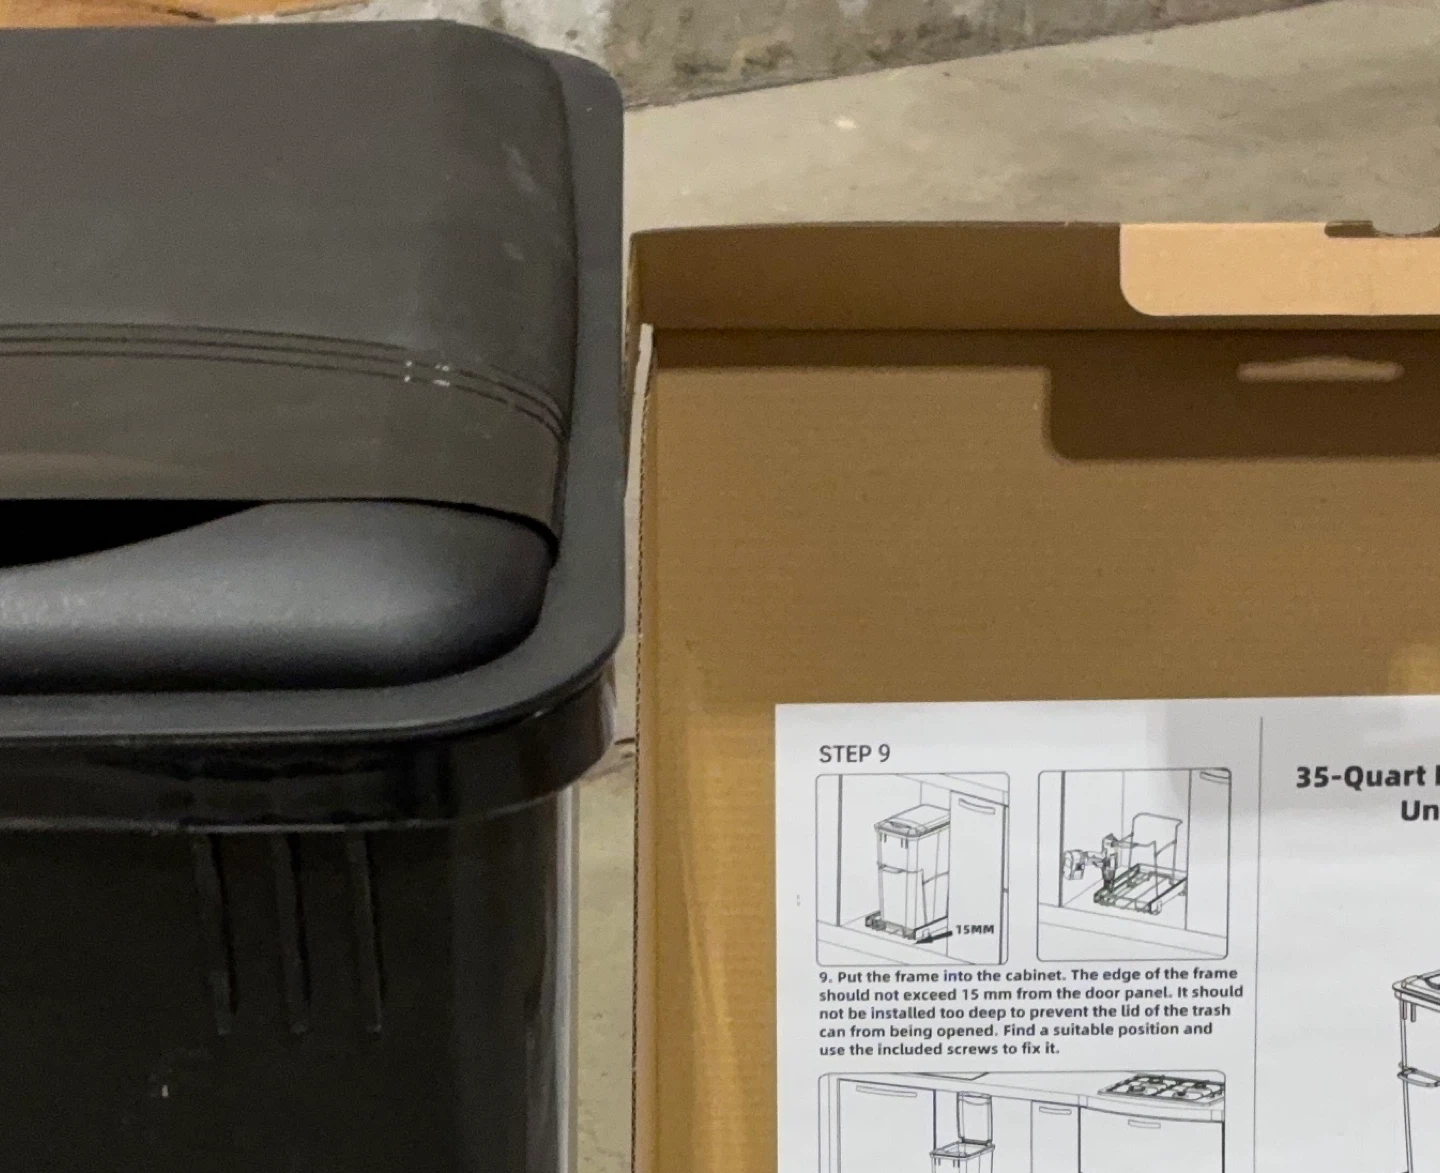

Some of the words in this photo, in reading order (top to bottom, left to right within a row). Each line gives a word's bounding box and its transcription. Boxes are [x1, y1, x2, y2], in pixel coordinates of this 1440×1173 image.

[819, 744, 872, 765] STEP
[878, 743, 890, 764] 9
[1296, 764, 1427, 792] 35-Quart
[956, 924, 994, 936] 15MM
[819, 971, 832, 984] 9.
[838, 970, 863, 984] Put
[866, 969, 890, 984] the
[894, 969, 939, 984] frame
[944, 968, 973, 983] into
[977, 968, 1001, 983] the
[1006, 967, 1066, 982] cabinet.
[1071, 967, 1099, 982] The
[1102, 966, 1141, 984] edge
[1145, 966, 1160, 981] of
[1164, 966, 1189, 981] the
[1193, 965, 1238, 980] frame
[819, 988, 870, 1003] should
[874, 989, 899, 1002] not
[903, 987, 957, 1002] exceed
[962, 987, 979, 1001] 15
[984, 990, 1012, 1001] mm
[1016, 986, 1052, 1001] from
[1056, 986, 1081, 1001] the
[1085, 985, 1120, 1000] door
[1125, 985, 1173, 1003] panel.
[1178, 985, 1188, 999] It
[1192, 984, 1243, 999] should
[819, 1007, 844, 1020] not
[848, 1006, 867, 1020] be
[871, 1005, 935, 1020] installed
[939, 1007, 964, 1020] too
[969, 1005, 1006, 1022] deep
[1010, 1006, 1025, 1019] to
[1030, 1005, 1089, 1022] prevent
[1092, 1004, 1117, 1018] the
[1121, 1003, 1140, 1018] lid
[1145, 1003, 1160, 1018] of
[1163, 1003, 1188, 1018] the
[1192, 1002, 1231, 1018] trash
[819, 1027, 845, 1039] can
[850, 1024, 885, 1039] from
[890, 1023, 932, 1041] being
[937, 1023, 998, 1041] opened.
[1004, 1022, 1035, 1037] Find
[1040, 1025, 1049, 1037] a
[1053, 1021, 1114, 1037] suitable
[1118, 1021, 1179, 1039] position
[1183, 1021, 1213, 1036] and
[820, 1046, 845, 1057] use
[849, 1042, 873, 1057] the
[878, 1041, 943, 1056] included
[947, 1044, 998, 1056] screws
[1002, 1042, 1018, 1055] to
[1021, 1040, 1040, 1055] fix
[1045, 1040, 1059, 1055] it.
